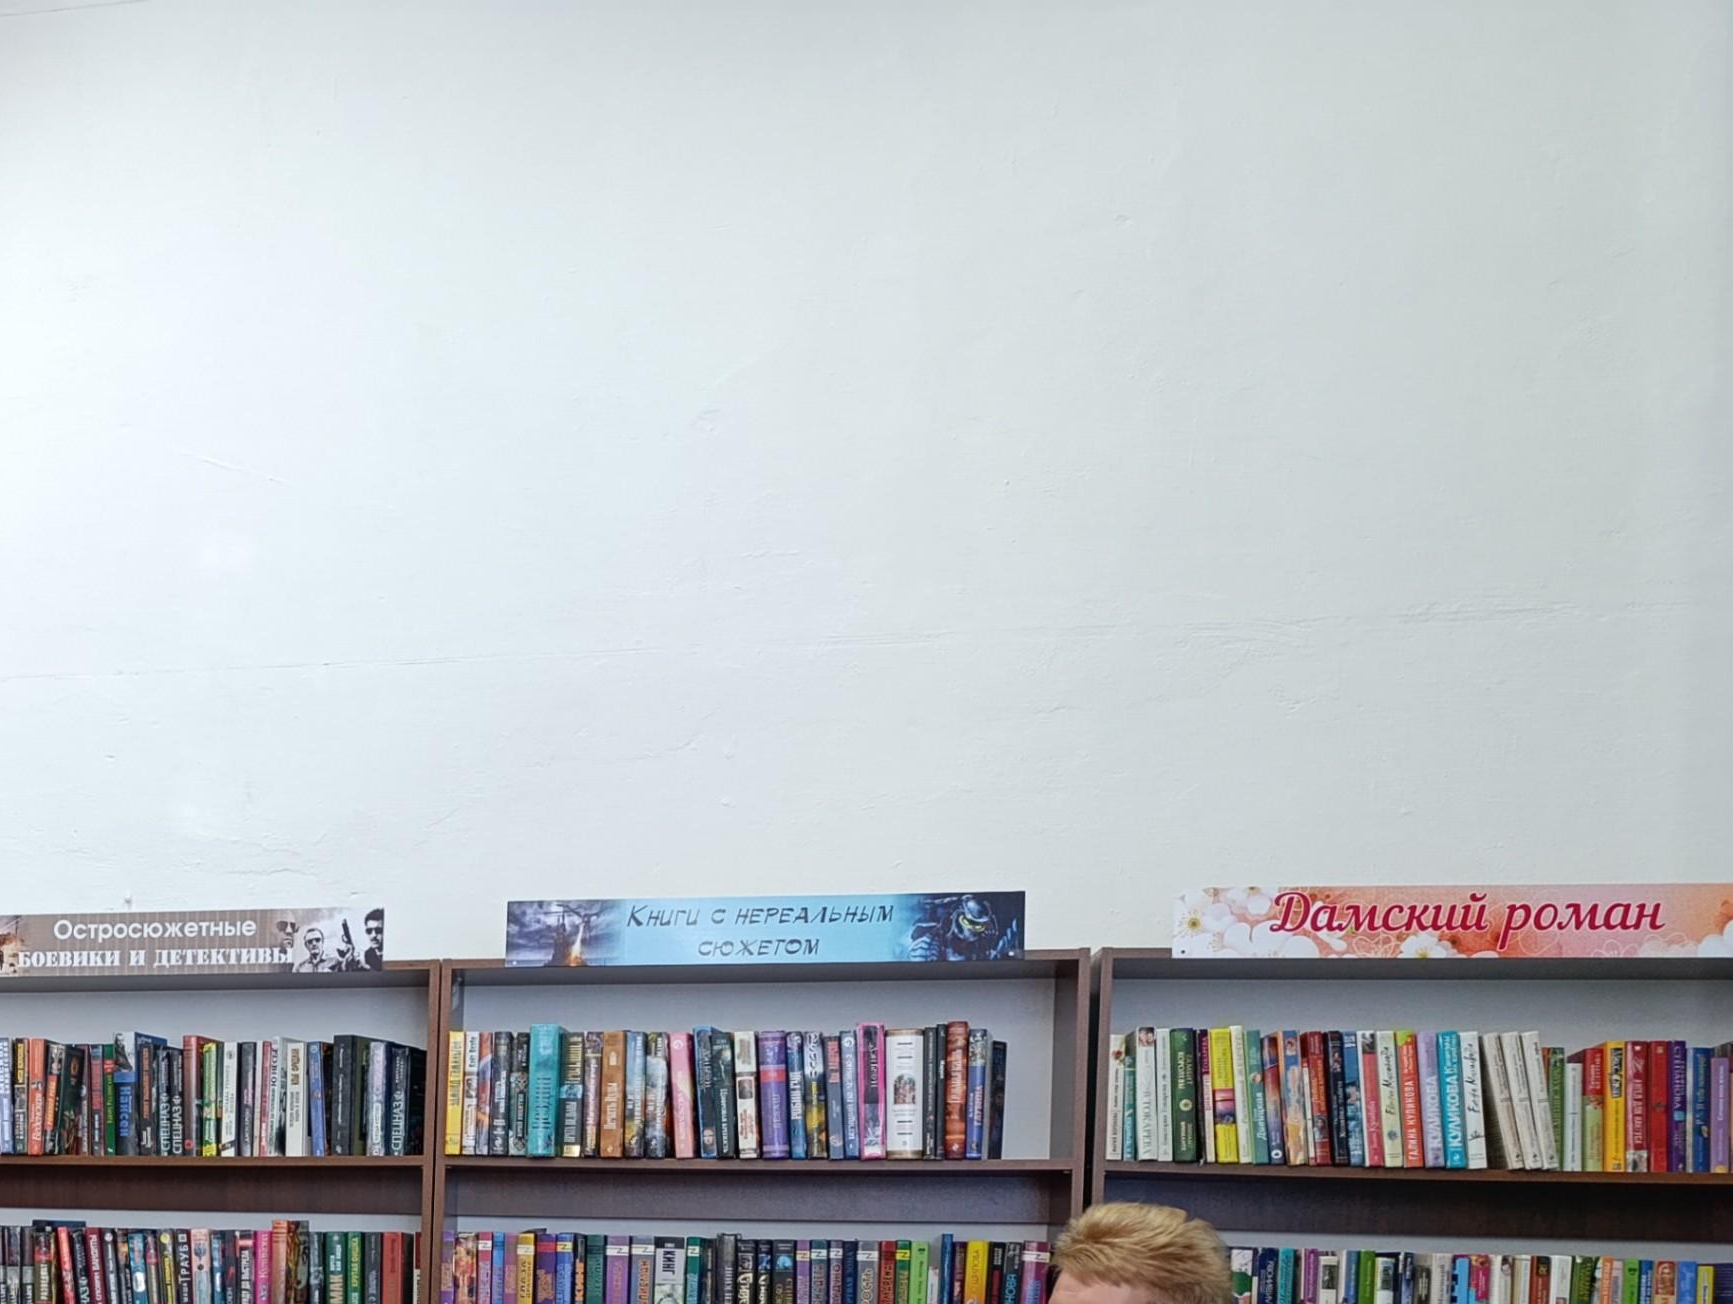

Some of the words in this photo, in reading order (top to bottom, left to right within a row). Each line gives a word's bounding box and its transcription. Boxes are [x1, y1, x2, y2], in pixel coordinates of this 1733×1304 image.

[52, 918, 257, 944] Остросюжетные
[1267, 891, 1491, 933] Дамский
[1498, 898, 1666, 952] роман
[18, 948, 122, 969] БОЕВИКИ
[129, 949, 146, 967] И
[153, 946, 295, 967] ДЕТЕКТИВЫ
[120, 1086, 130, 1137] Нансен
[160, 1100, 171, 1150] СПЕЦНАЗ
[172, 1103, 182, 1153] СПЕЦНАЗ
[392, 1099, 405, 1151] СПЕЦНАЗ
[1406, 1080, 1415, 1127] КУЛИКОВА
[1426, 1075, 1441, 1148] КУЛИКОВА
[1445, 1074, 1461, 1148] КУЛИКОВА
[178, 1243, 190, 1283] ТРАУБ
[574, 1259, 584, 1302] КИНГ
[662, 1250, 676, 1275] КИНГ
